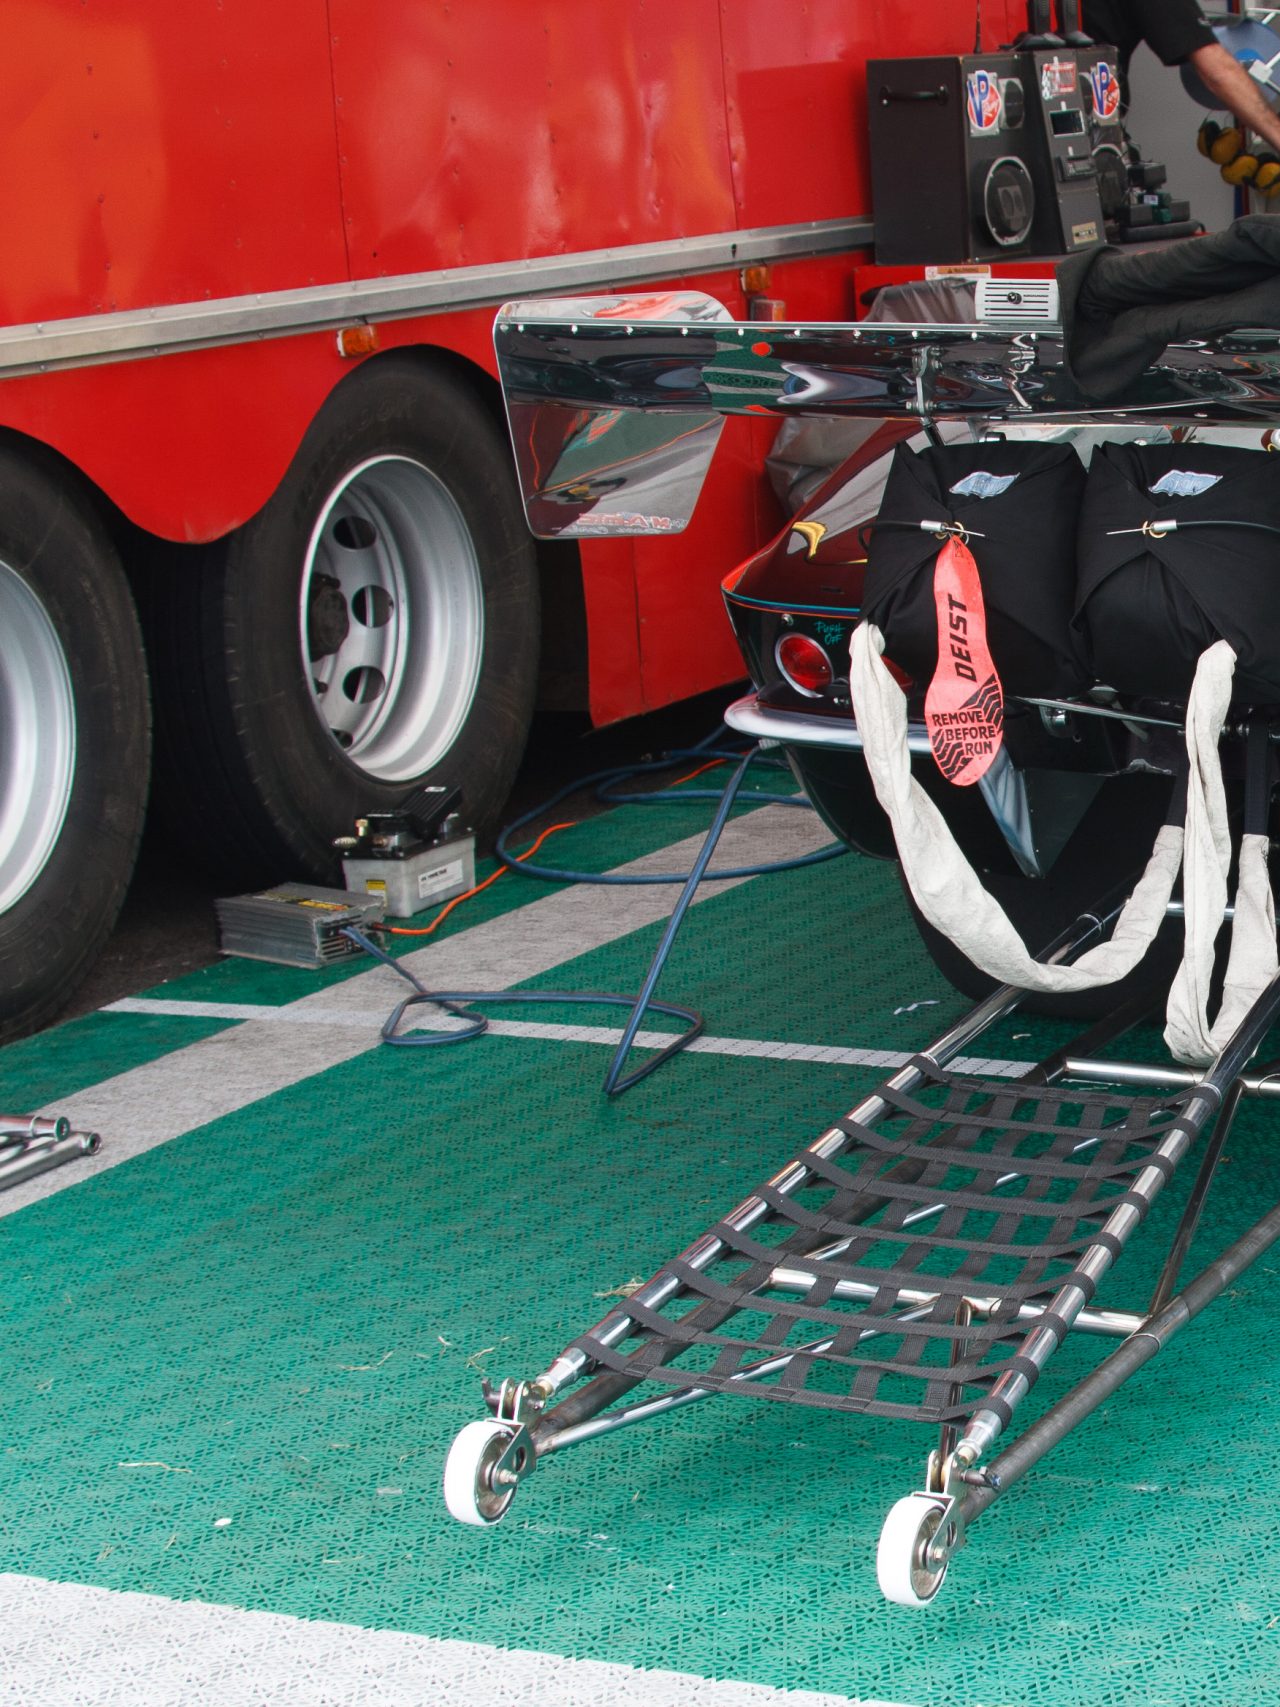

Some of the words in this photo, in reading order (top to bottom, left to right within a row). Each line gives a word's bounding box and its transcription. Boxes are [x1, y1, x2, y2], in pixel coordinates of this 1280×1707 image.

[967, 71, 989, 128] VP
[1091, 63, 1111, 117] VP
[948, 593, 977, 683] DEIST
[932, 711, 984, 727] REMOVE
[946, 726, 996, 742] BEFORE
[965, 740, 993, 756] RUN
